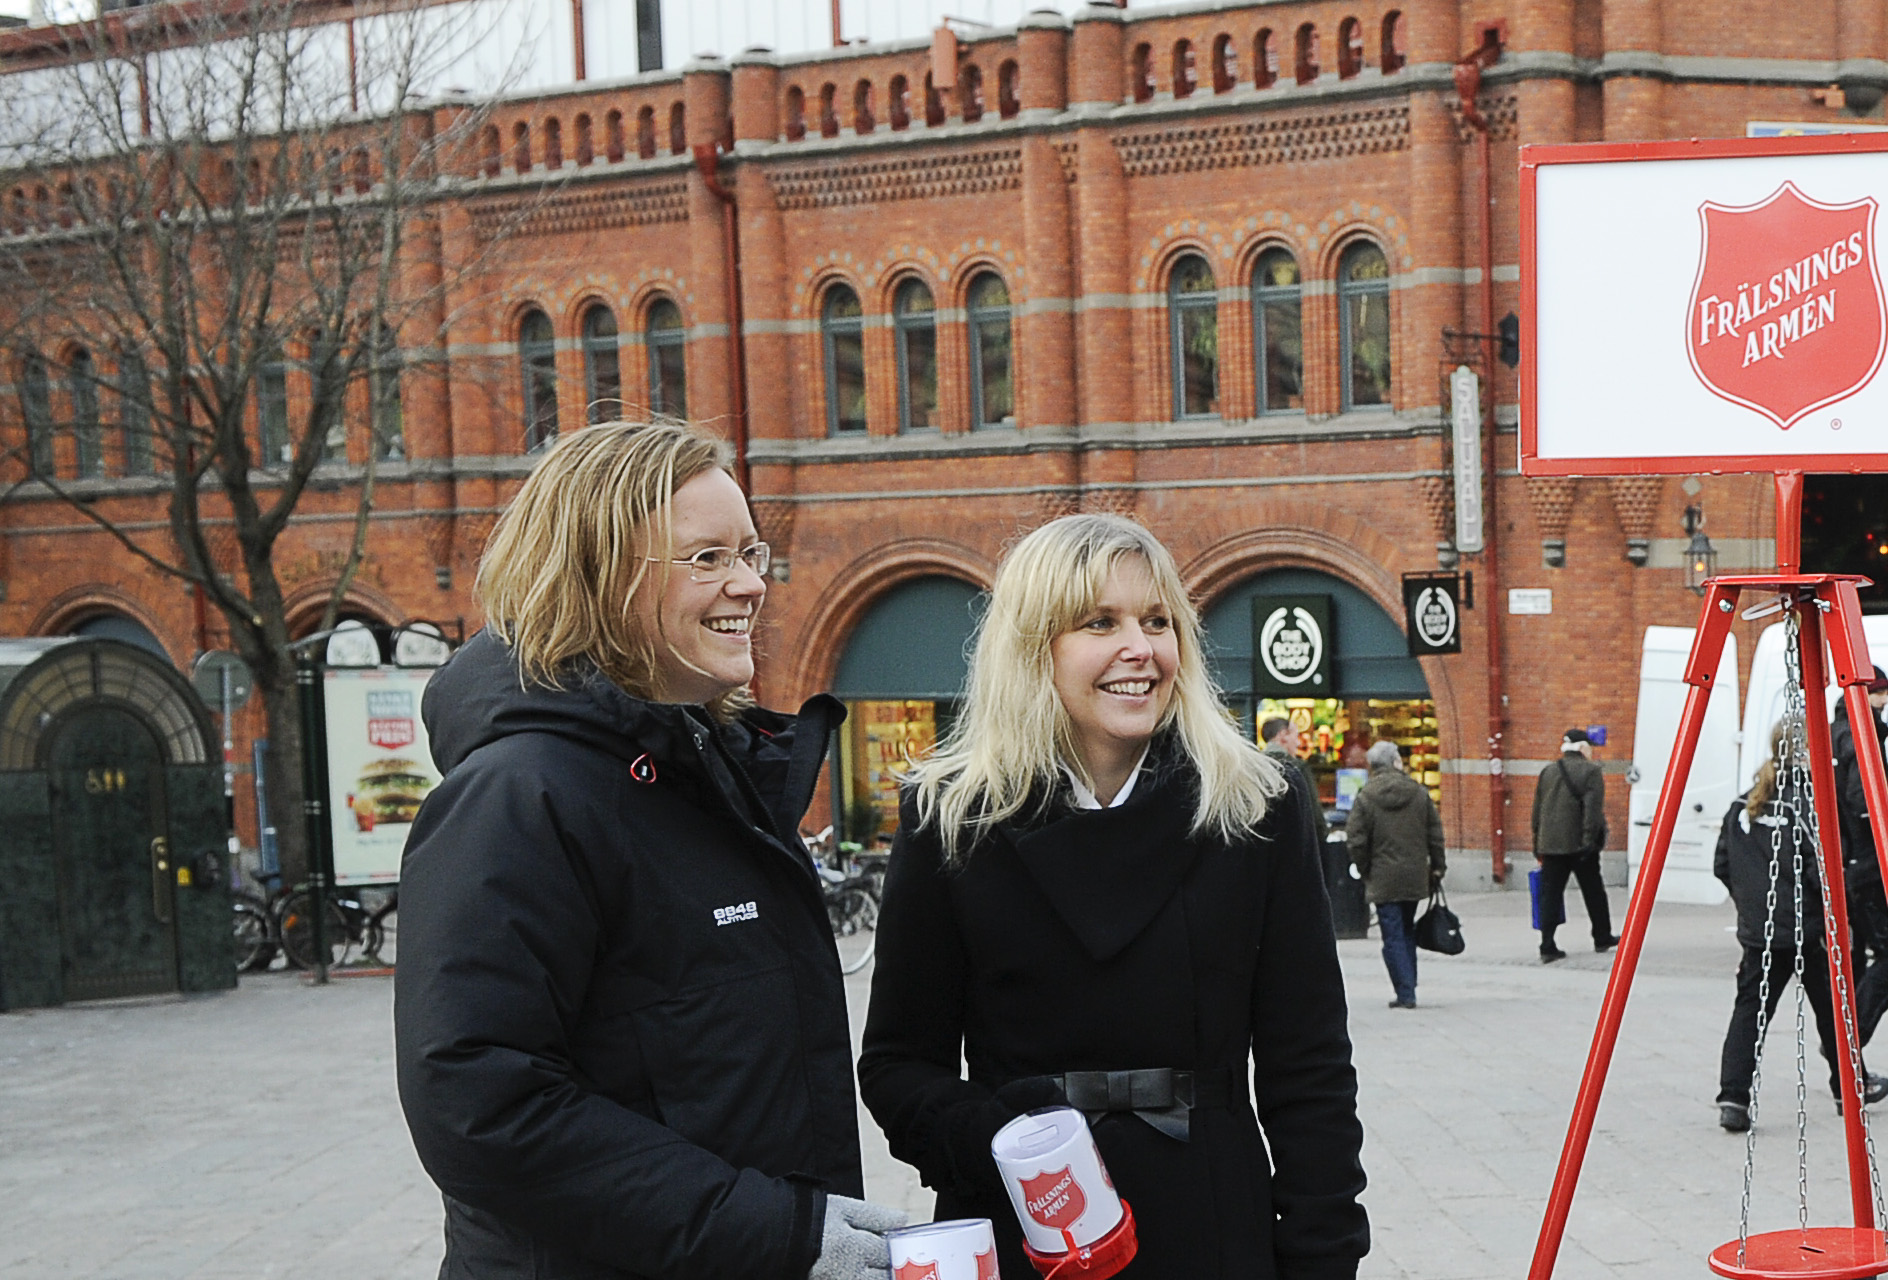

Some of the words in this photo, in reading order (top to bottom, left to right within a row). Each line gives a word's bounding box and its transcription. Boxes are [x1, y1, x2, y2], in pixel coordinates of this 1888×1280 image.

[1699, 231, 1863, 346] FRÄLSNINGS
[1742, 288, 1837, 368] ARMÉN
[1280, 629, 1302, 642] THE
[1272, 641, 1310, 657] BODY
[1275, 655, 1310, 670] SHOP
[713, 901, 757, 920] 8848
[717, 911, 759, 927] ALTITUDE
